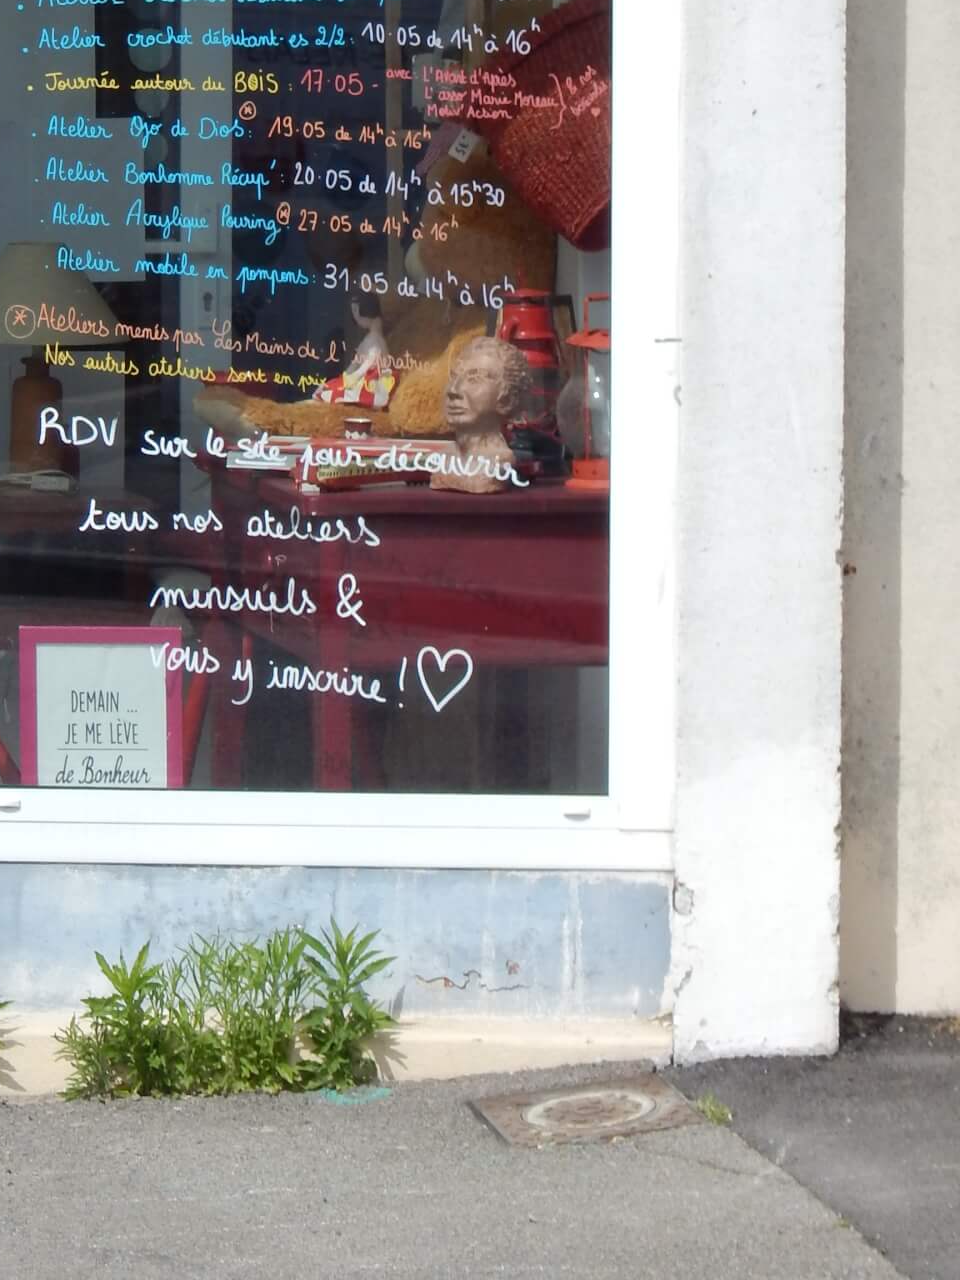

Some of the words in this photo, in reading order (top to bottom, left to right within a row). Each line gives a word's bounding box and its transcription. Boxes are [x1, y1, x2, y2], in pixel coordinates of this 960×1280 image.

[39, 26, 105, 50] Atelier
[127, 26, 192, 48] crochet
[427, 29, 444, 49] de
[485, 35, 499, 53] à
[45, 70, 120, 91] Journée
[130, 75, 195, 91] autour
[202, 75, 225, 91] du
[234, 69, 279, 94] BOIS
[48, 115, 112, 139] Atelier
[171, 119, 189, 137] de
[335, 126, 352, 142] de
[385, 129, 397, 148] à
[46, 157, 110, 183] Atelier
[125, 161, 214, 186] Bonhomme
[359, 175, 377, 195] de
[428, 181, 445, 205] à
[52, 201, 110, 227] Atelier
[126, 198, 209, 242] Acrylique
[221, 204, 281, 245] Pouring
[359, 218, 377, 234] de
[412, 222, 424, 240] à
[57, 247, 121, 273] Atelier
[135, 252, 199, 277] mobile
[205, 266, 228, 279] en
[397, 278, 419, 298] de
[460, 283, 475, 306] à
[37, 303, 110, 337] Ateliers
[115, 320, 169, 341] menés
[173, 328, 205, 352] par
[246, 332, 295, 356] Mains
[297, 340, 321, 360] de
[44, 342, 76, 367] Nos
[84, 351, 140, 376] autres
[149, 359, 217, 381] ateliers
[227, 366, 267, 385] sont
[273, 372, 293, 385] en
[40, 407, 119, 446] RDV
[205, 428, 228, 458] le
[237, 430, 288, 462] site
[301, 445, 366, 480] pour
[373, 444, 530, 488] découvrir
[80, 498, 158, 533] tous
[173, 508, 223, 534] nos
[247, 506, 381, 547] ateliers
[150, 577, 318, 616] mensuels
[336, 573, 366, 626] &
[71, 690, 119, 713] DEMAIN
[232, 659, 254, 705] y
[267, 661, 386, 703] inscrire
[65, 723, 78, 744] JE
[85, 721, 102, 744] ME
[110, 718, 139, 744] LÈVE
[55, 754, 74, 784] de
[79, 754, 152, 784] Bonheur
